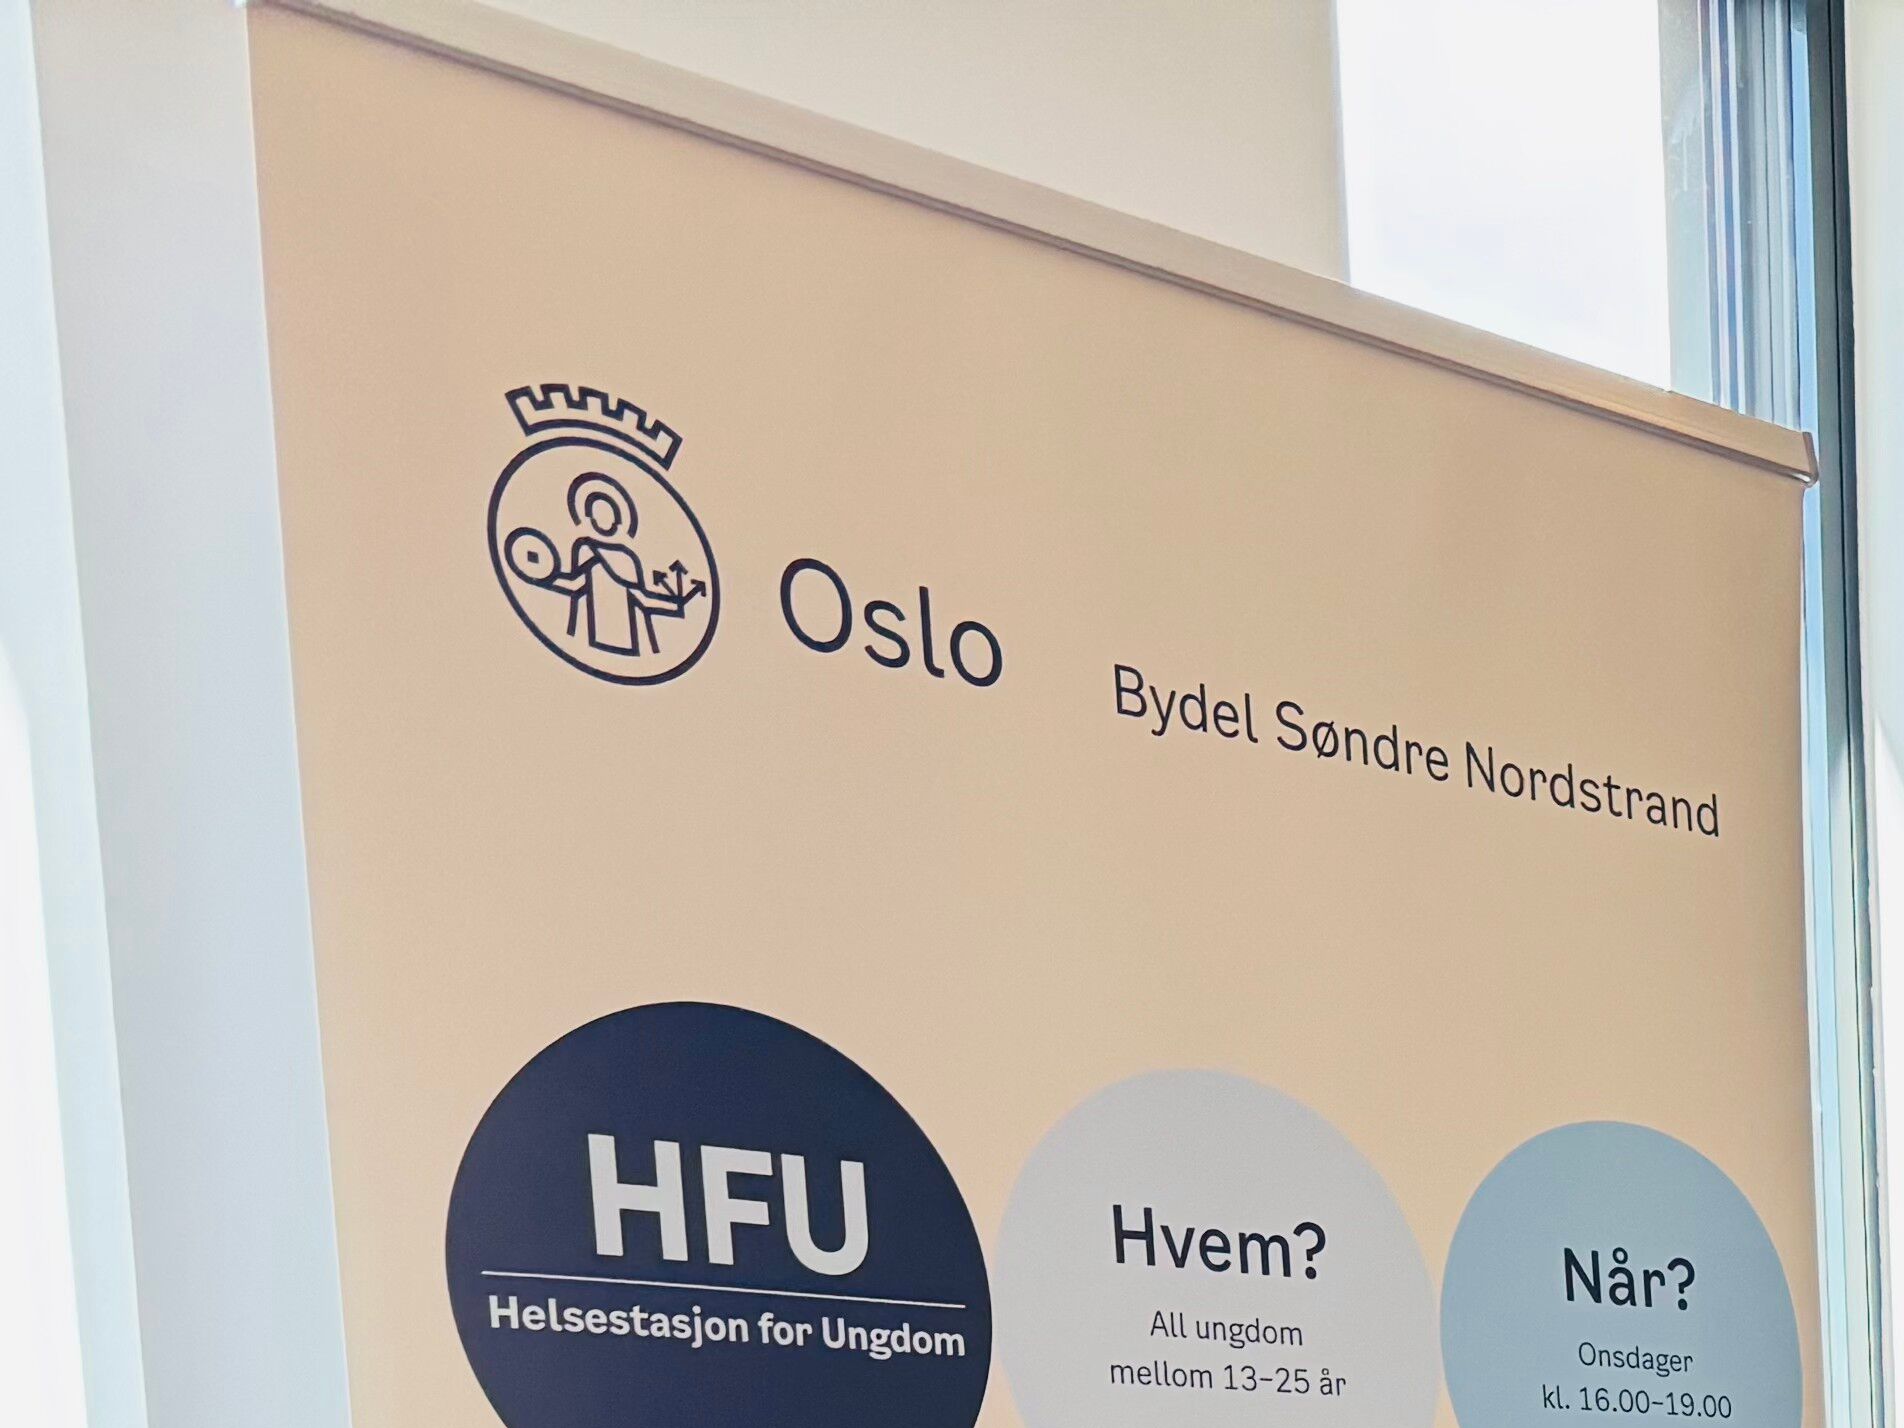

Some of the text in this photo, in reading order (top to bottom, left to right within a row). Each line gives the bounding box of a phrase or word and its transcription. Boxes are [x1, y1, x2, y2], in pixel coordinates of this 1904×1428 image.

[779, 557, 1003, 688] Oslo
[1114, 663, 1719, 838] Bydel Søndre Nordstrand
[587, 1133, 869, 1276] HFU
[1112, 1204, 1326, 1280] Hvem?
[1563, 1246, 1695, 1311] Når?
[488, 1294, 966, 1361] Helsestasjon for Ungdom
[1150, 1310, 1303, 1350] All ungdom
[1578, 1341, 1694, 1374] Onsdager
[1110, 1360, 1213, 1389] mellom
[1319, 1367, 1347, 1396] år
[1542, 1383, 1570, 1410] kl.
